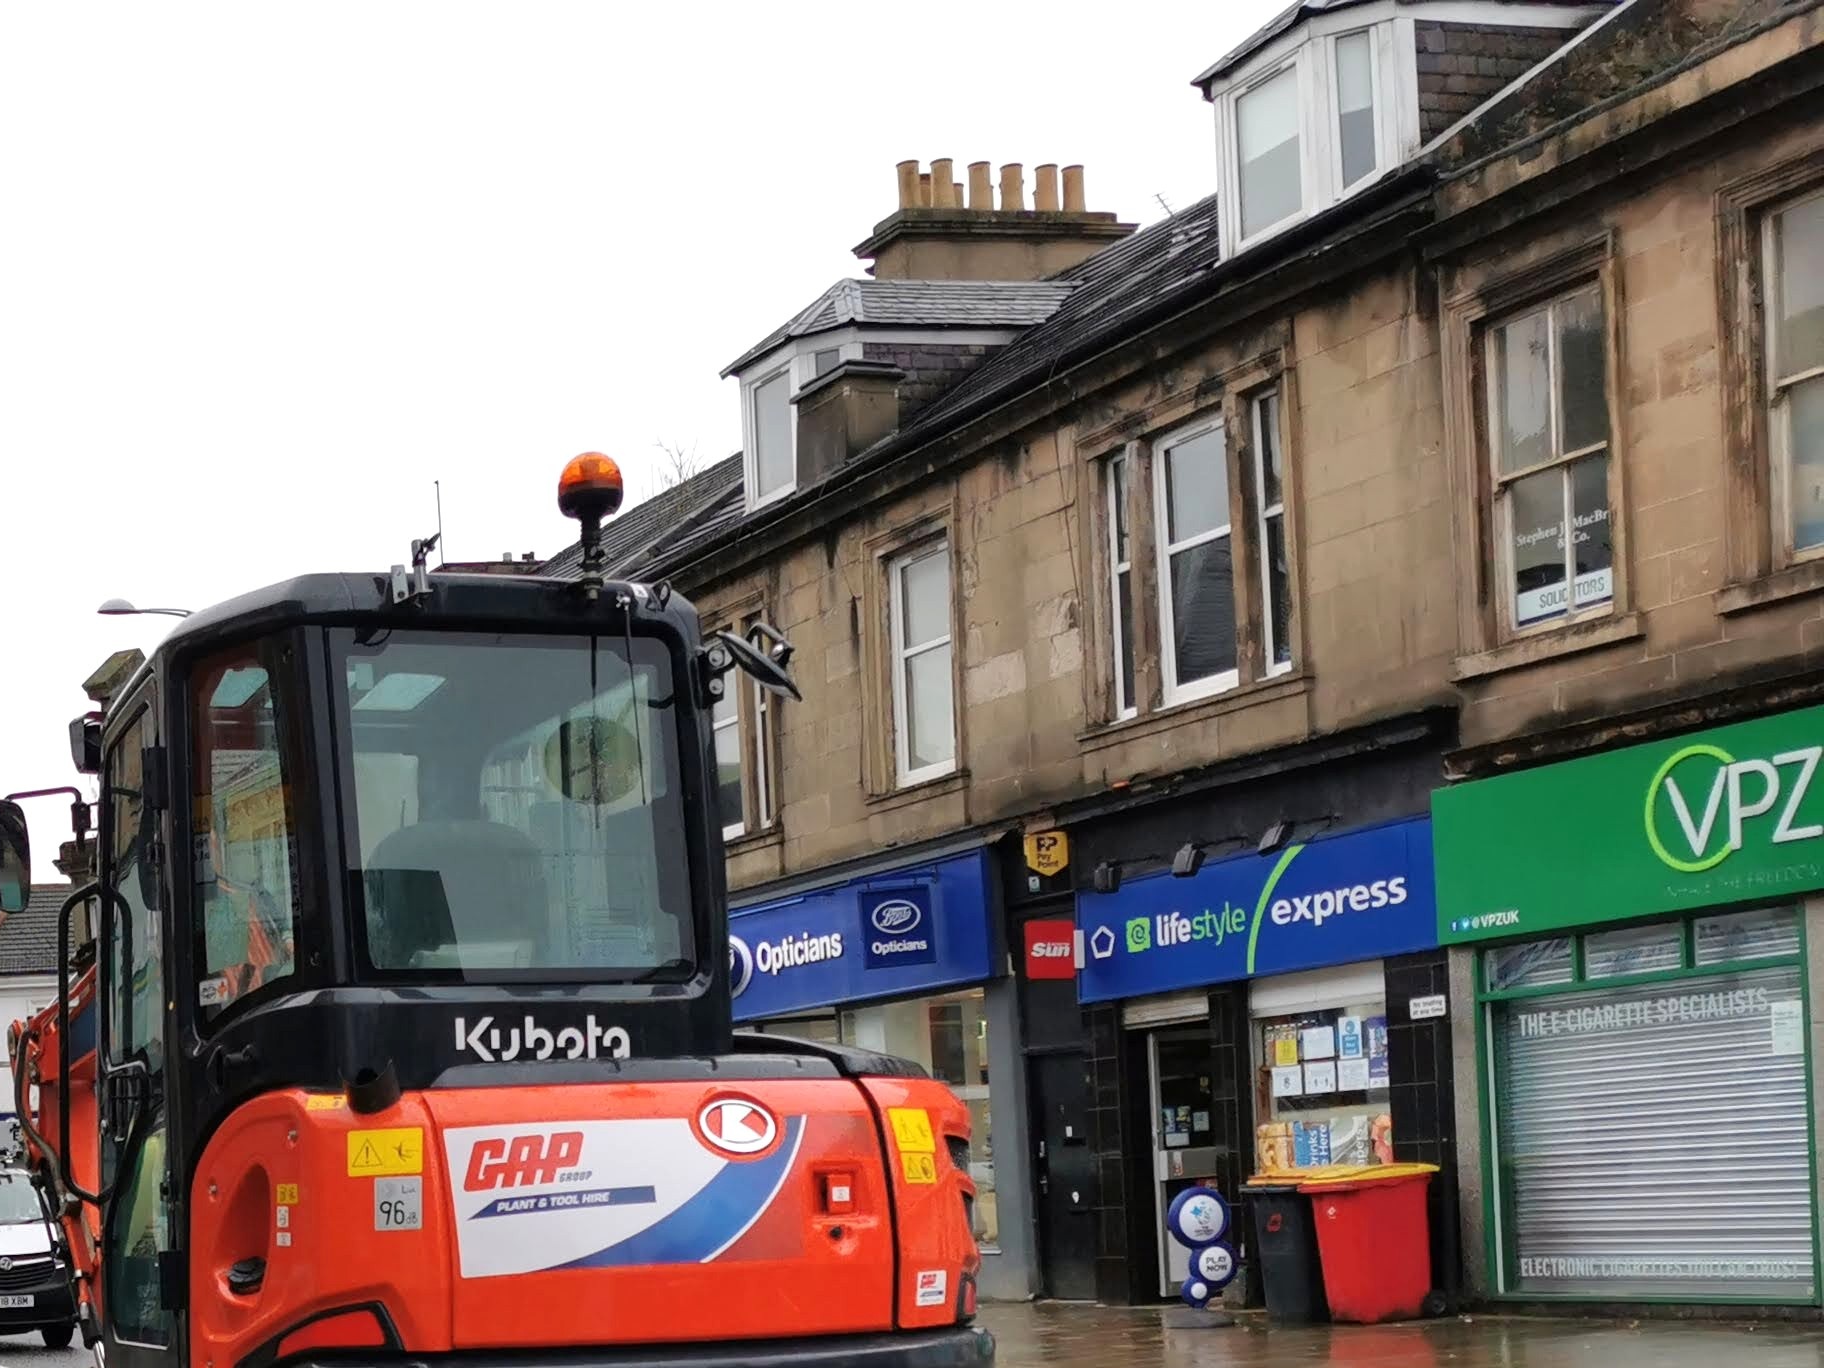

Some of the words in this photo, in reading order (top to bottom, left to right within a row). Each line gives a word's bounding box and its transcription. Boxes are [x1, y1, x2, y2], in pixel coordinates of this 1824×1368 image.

[1516, 525, 1558, 548] Stephen
[1539, 576, 1606, 609] SOLICTORS
[1664, 745, 1823, 858] VPZ
[1155, 901, 1246, 946] lifestyle
[1270, 876, 1408, 926] express
[756, 932, 844, 975] Opticians
[871, 939, 928, 956] Opticians
[1030, 942, 1071, 958] Sun
[1518, 1012, 1547, 1037] THE
[1656, 987, 1769, 1022] SPECIALISTS
[454, 1014, 631, 1062] Kubota
[463, 1131, 584, 1192] GAP
[558, 1170, 593, 1183] GROUP
[379, 1200, 406, 1226] 96
[496, 1198, 537, 1213] PLANT
[550, 1195, 580, 1208] TOOL
[581, 1191, 611, 1204] HIRE
[1206, 1263, 1228, 1272] NOW
